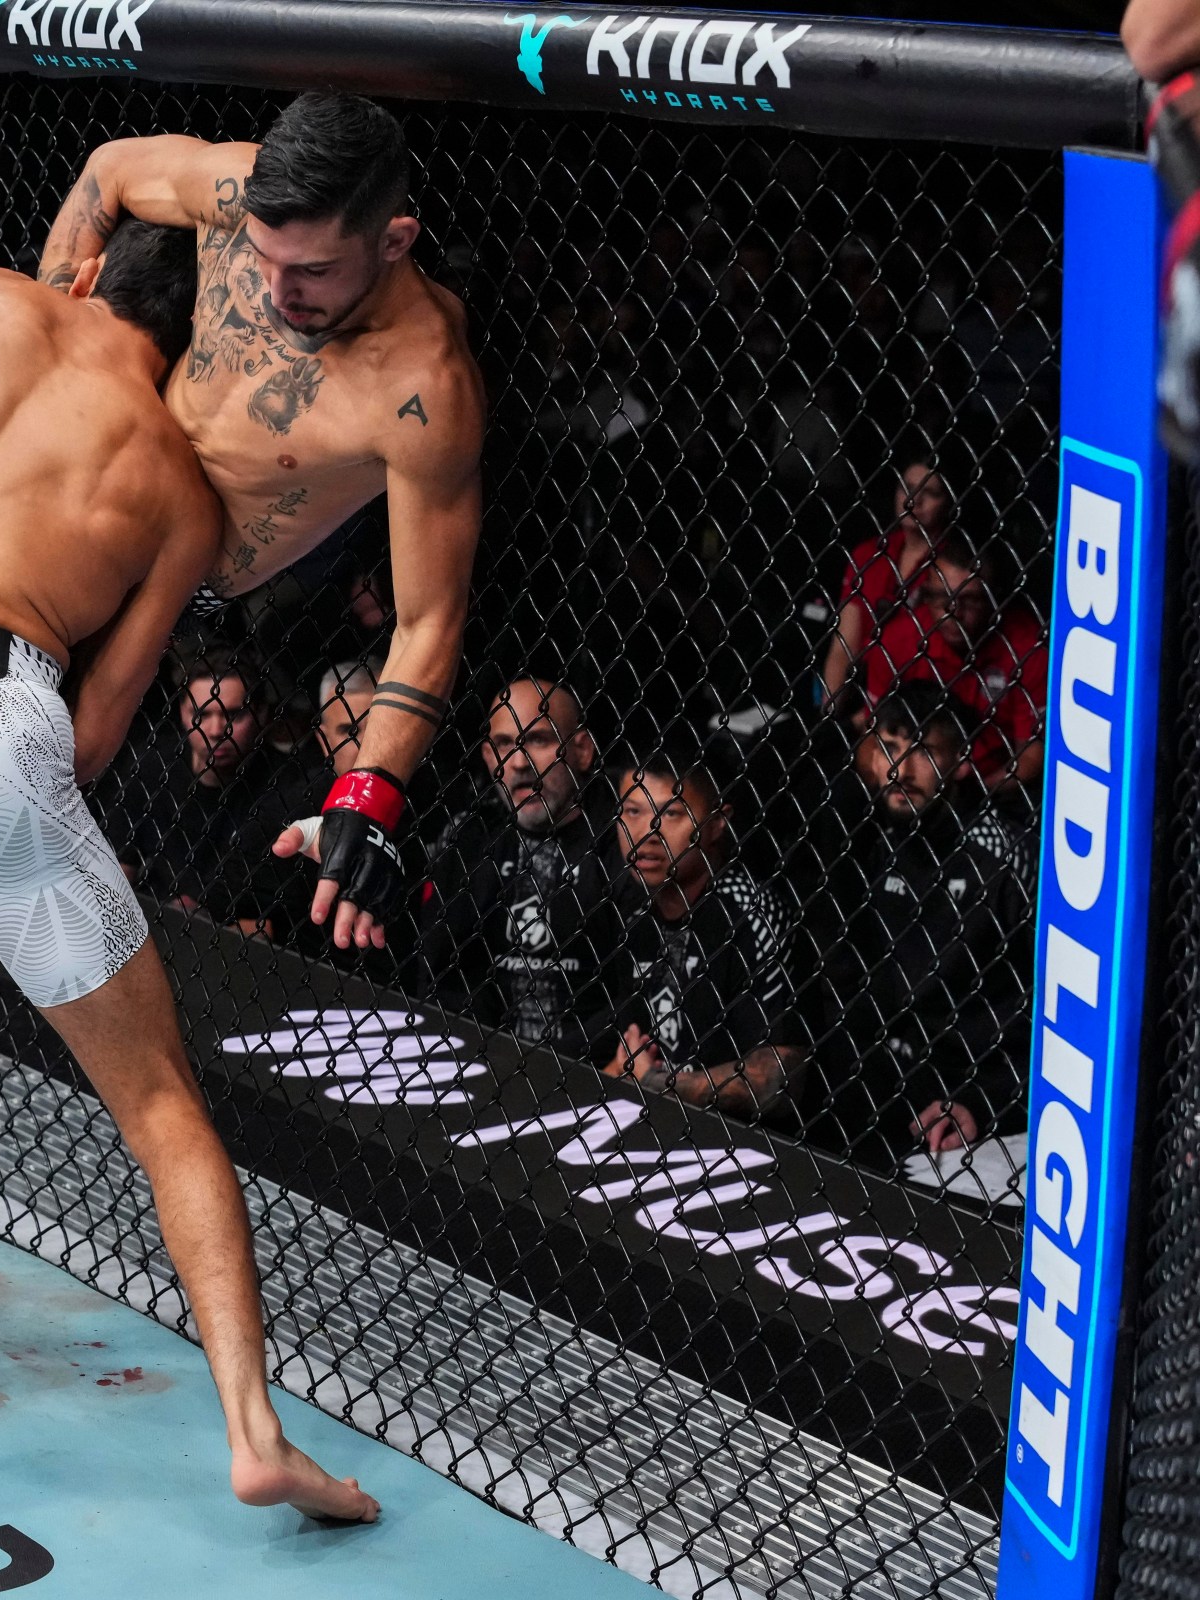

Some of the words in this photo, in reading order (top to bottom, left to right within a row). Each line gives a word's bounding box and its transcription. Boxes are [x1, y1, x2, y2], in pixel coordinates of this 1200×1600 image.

[7, 0, 150, 51] KNOX
[586, 15, 812, 88] KNOX
[33, 54, 139, 70] HYDRATE
[620, 88, 775, 113] HYDRATE
[1053, 484, 1122, 912] BUD
[1017, 923, 1100, 1508] LIGHT
